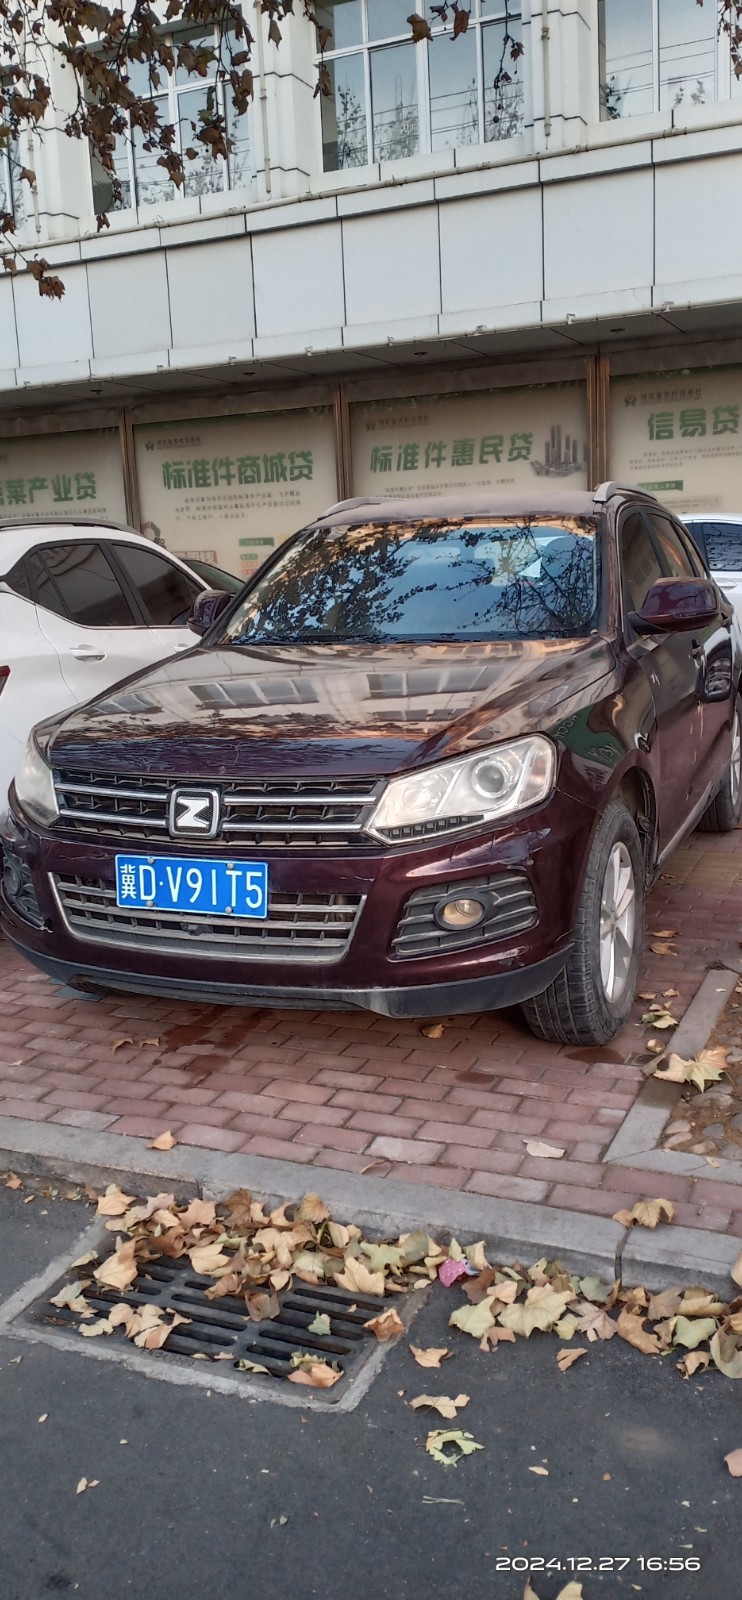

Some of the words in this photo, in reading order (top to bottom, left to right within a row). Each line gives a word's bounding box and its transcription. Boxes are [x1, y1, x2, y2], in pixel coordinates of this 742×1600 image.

[647, 405, 740, 441] 信易贷
[162, 450, 313, 490] 标准件商城贷
[370, 432, 534, 473] 标准件惠民贷
[0, 472, 97, 505] 菜产业贷
[120, 864, 263, 909] 冀D·V91T5
